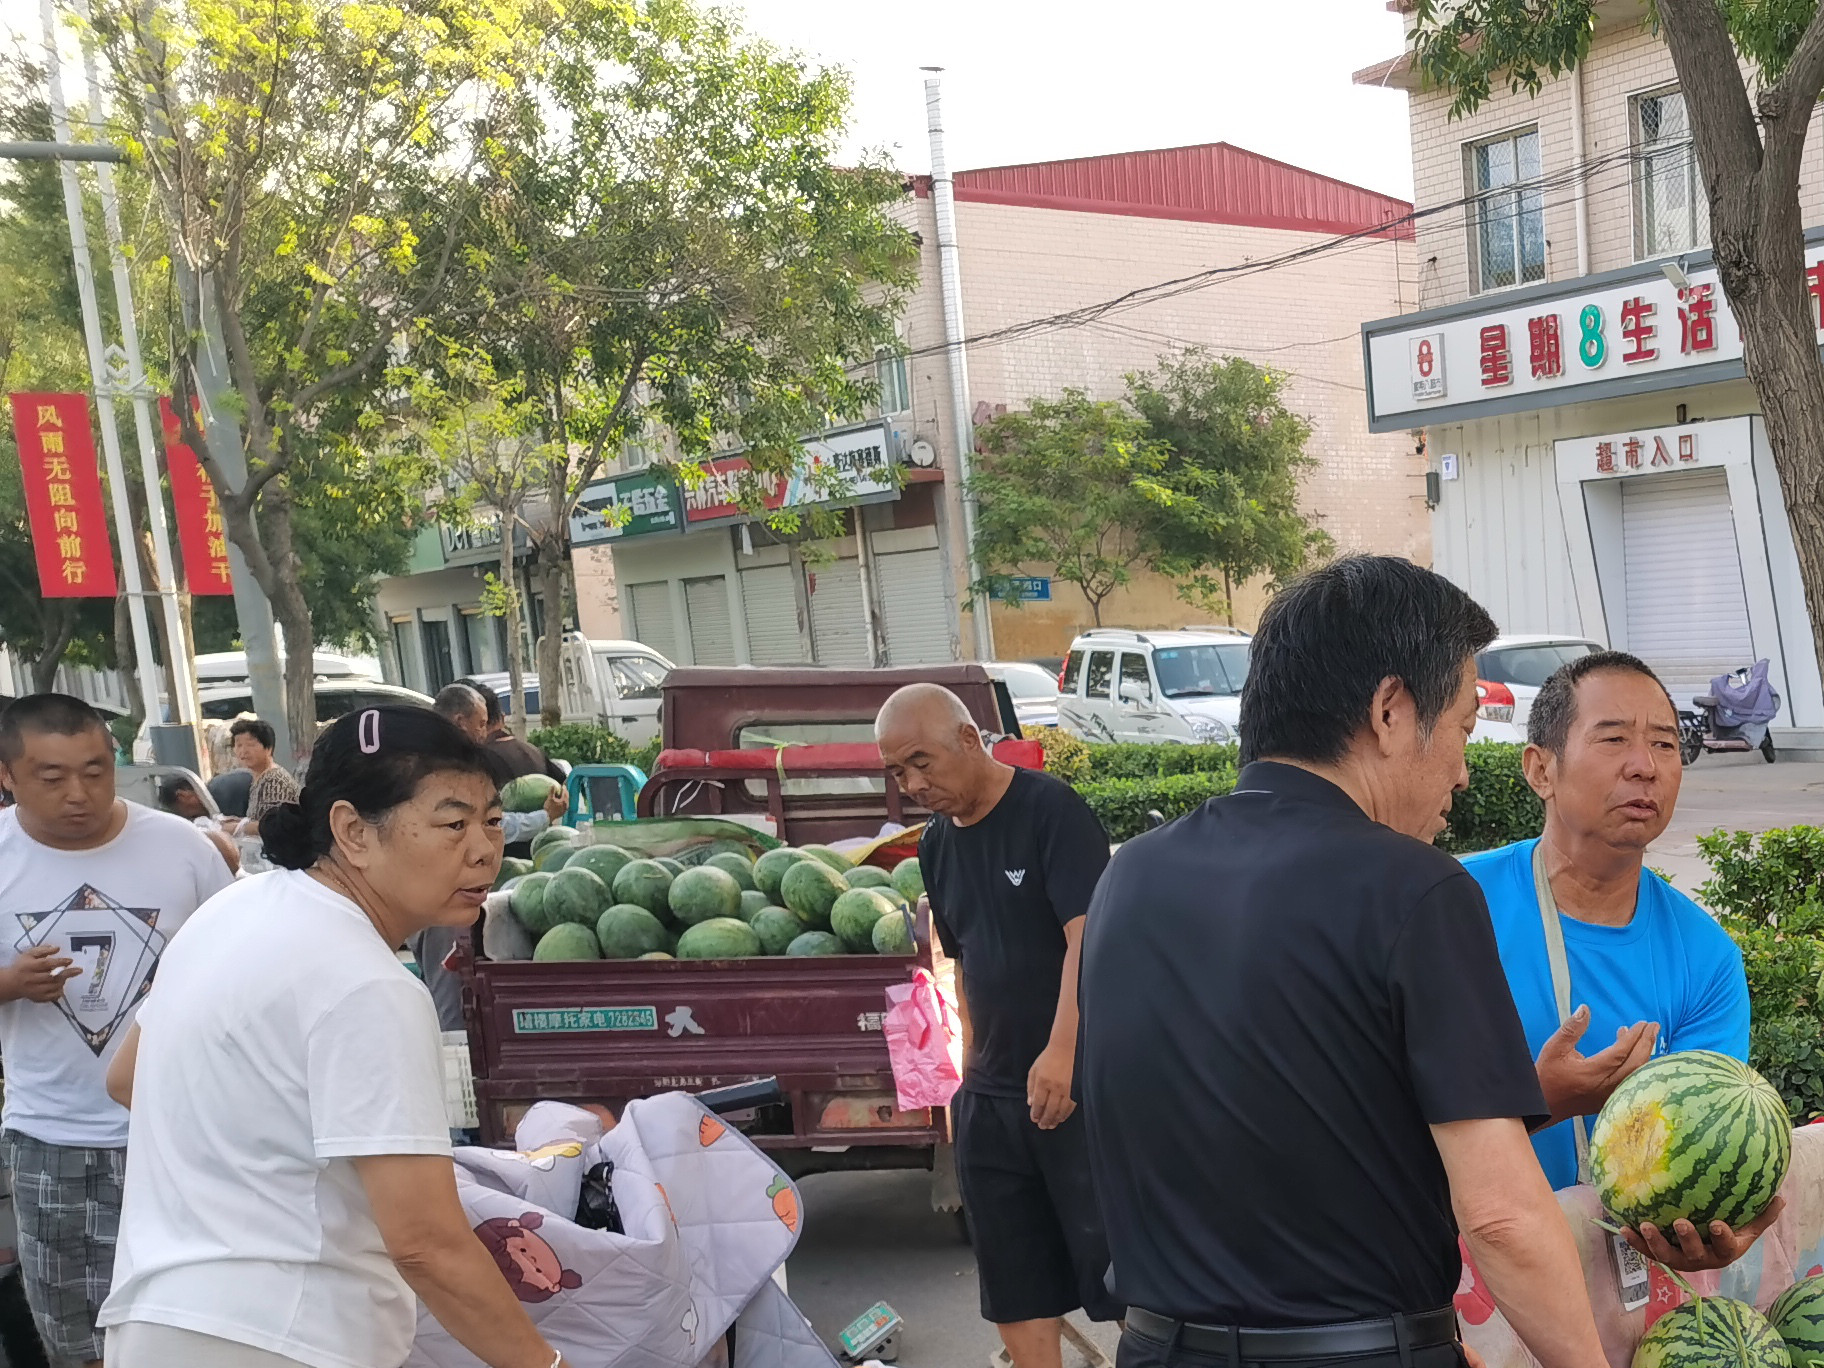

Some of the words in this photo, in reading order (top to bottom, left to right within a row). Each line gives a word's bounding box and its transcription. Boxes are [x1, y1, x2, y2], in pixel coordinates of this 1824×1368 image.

[1596, 433, 1699, 473] 超市入口
[37, 404, 87, 584] 风雨无阻向前行
[857, 1011, 888, 1031] 福
